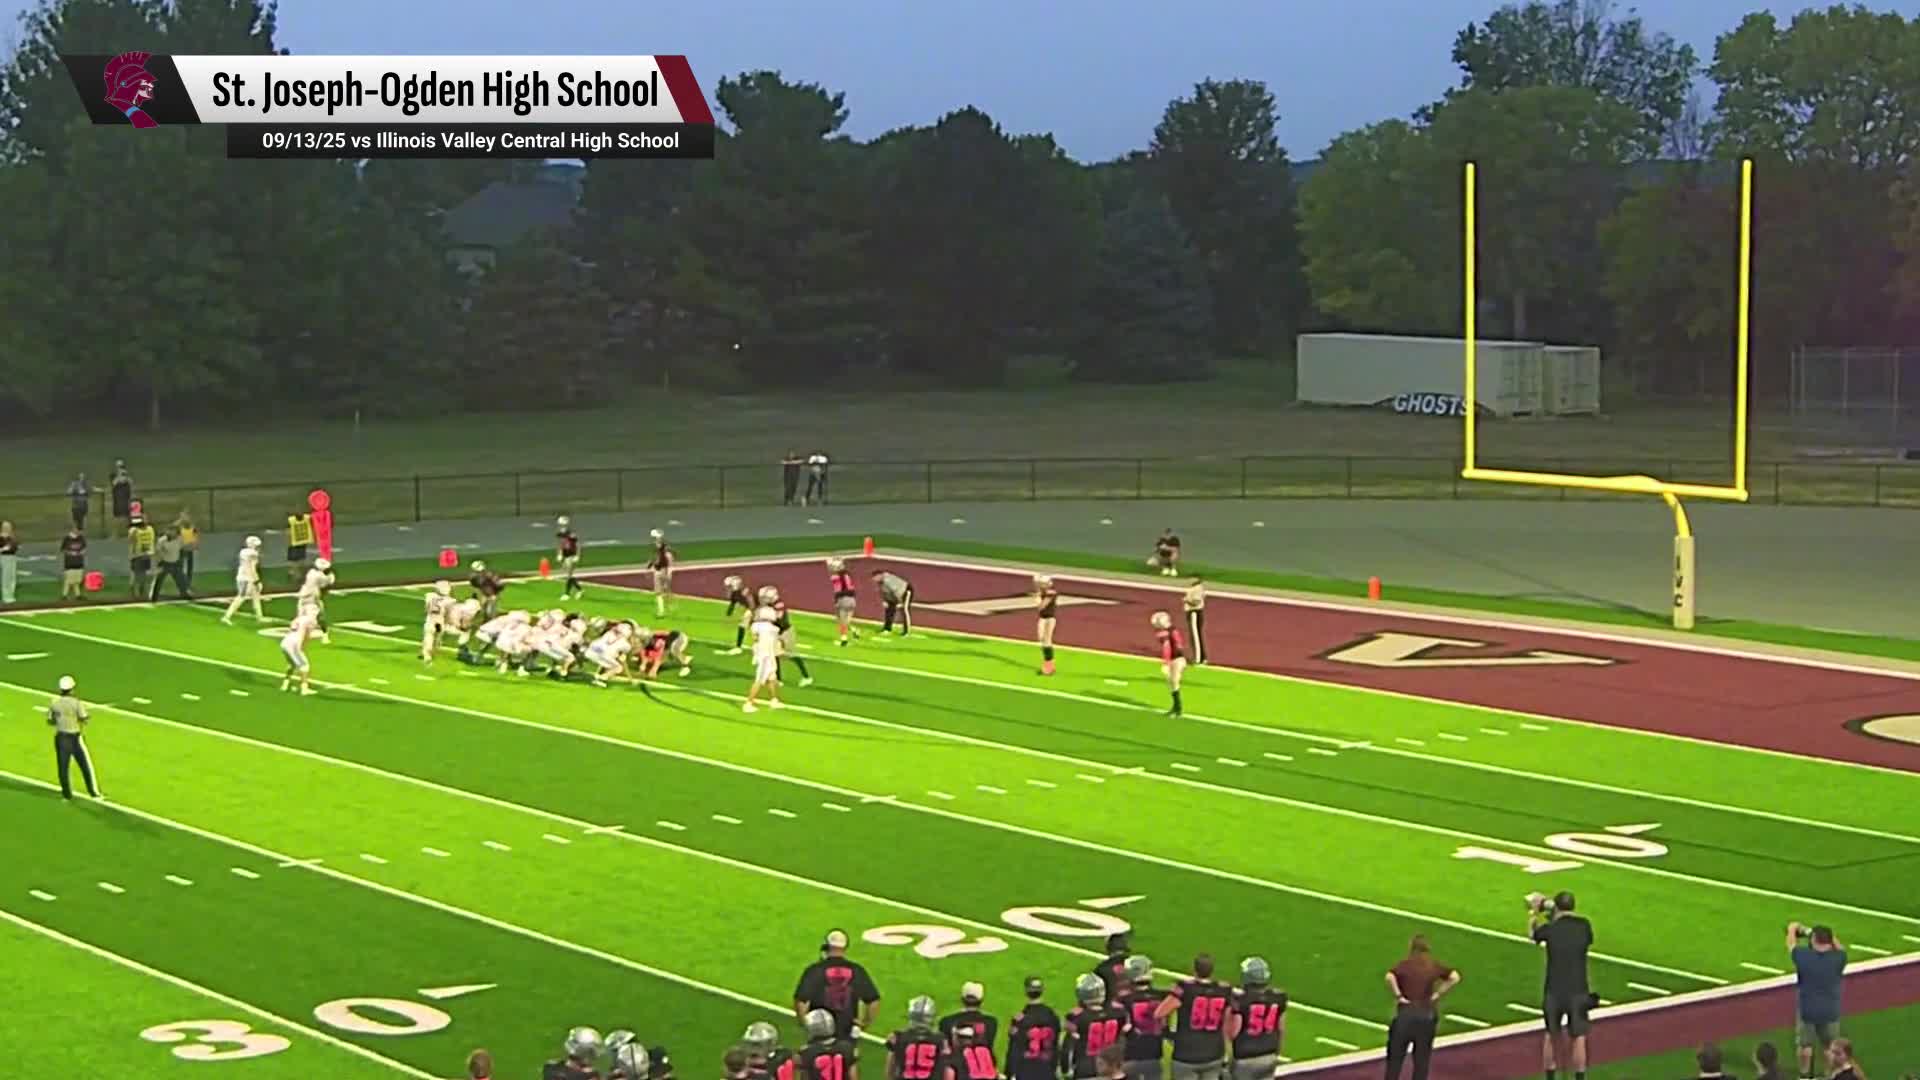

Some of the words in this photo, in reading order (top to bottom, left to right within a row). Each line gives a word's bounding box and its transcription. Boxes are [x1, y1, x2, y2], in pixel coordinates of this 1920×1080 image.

[861, 906, 1131, 959] 20
[139, 997, 452, 1061] 30
[1247, 1002, 1280, 1037] 54
[902, 1043, 938, 1079] 15
